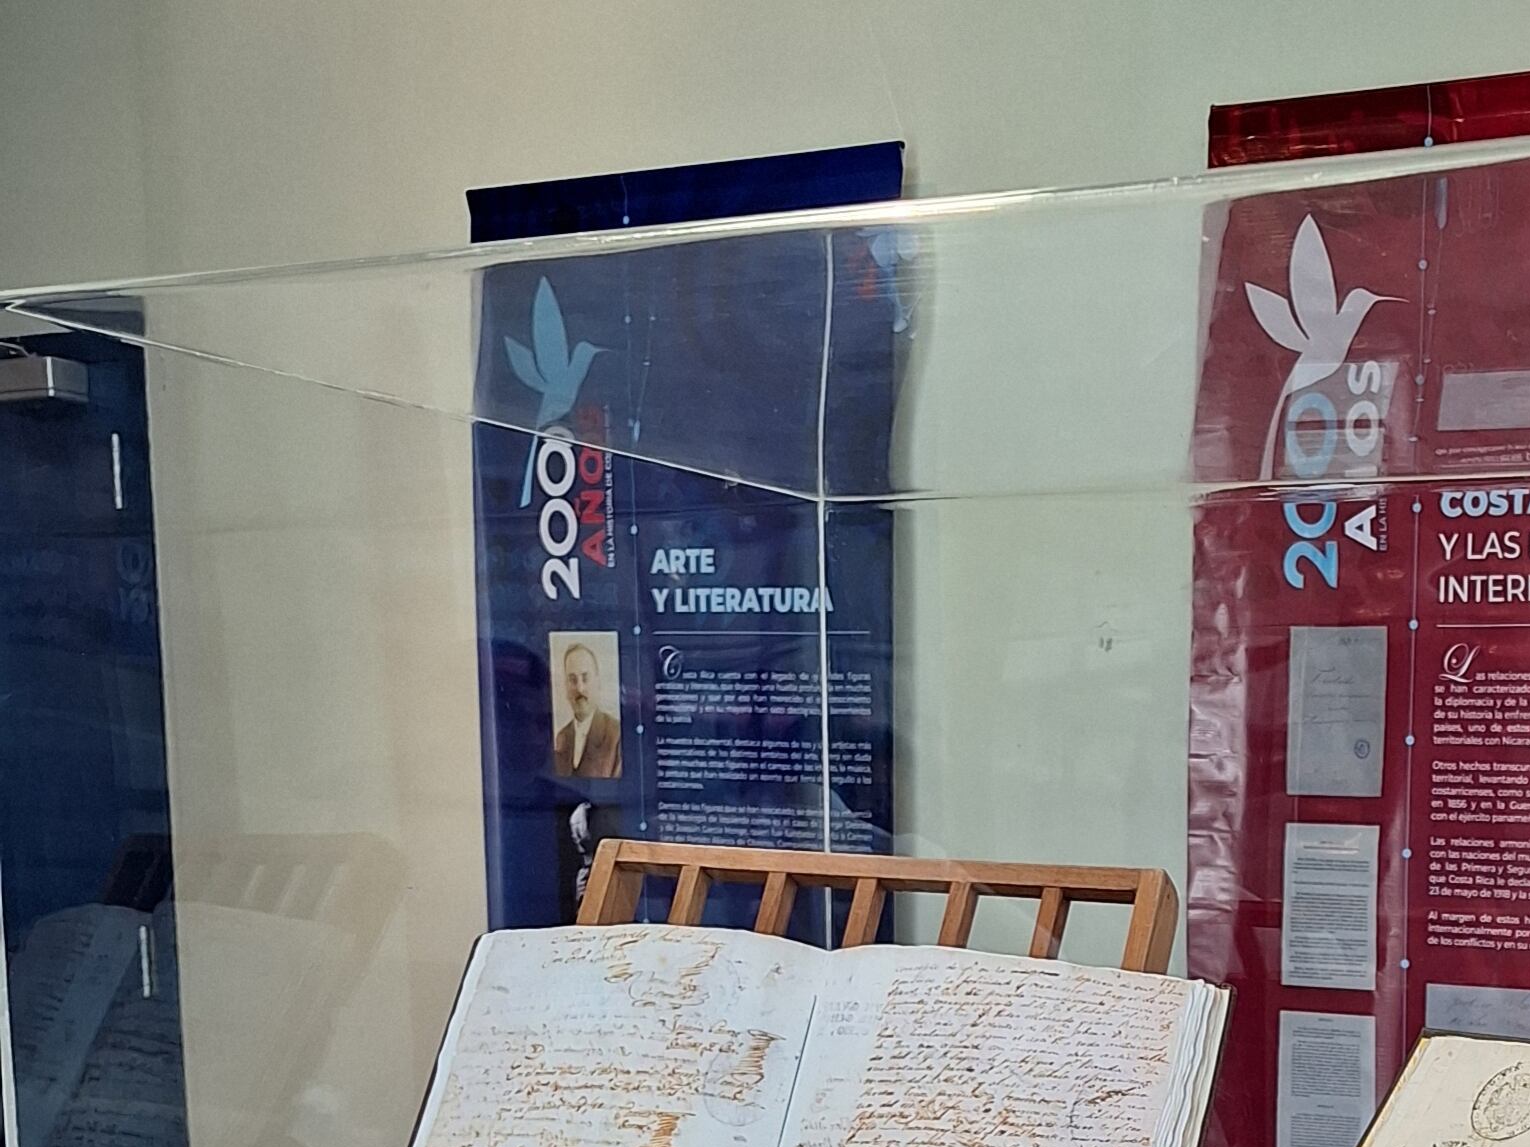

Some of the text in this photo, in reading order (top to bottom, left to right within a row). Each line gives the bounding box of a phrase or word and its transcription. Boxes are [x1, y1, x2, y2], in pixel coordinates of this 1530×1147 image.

[1283, 392, 1339, 589] 200
[1344, 360, 1382, 551] AOS
[537, 426, 581, 600] 200
[650, 548, 715, 575] ARTE
[1438, 533, 1459, 560] Y
[1466, 531, 1521, 560] LAS
[652, 587, 834, 614] Y LITERATURA
